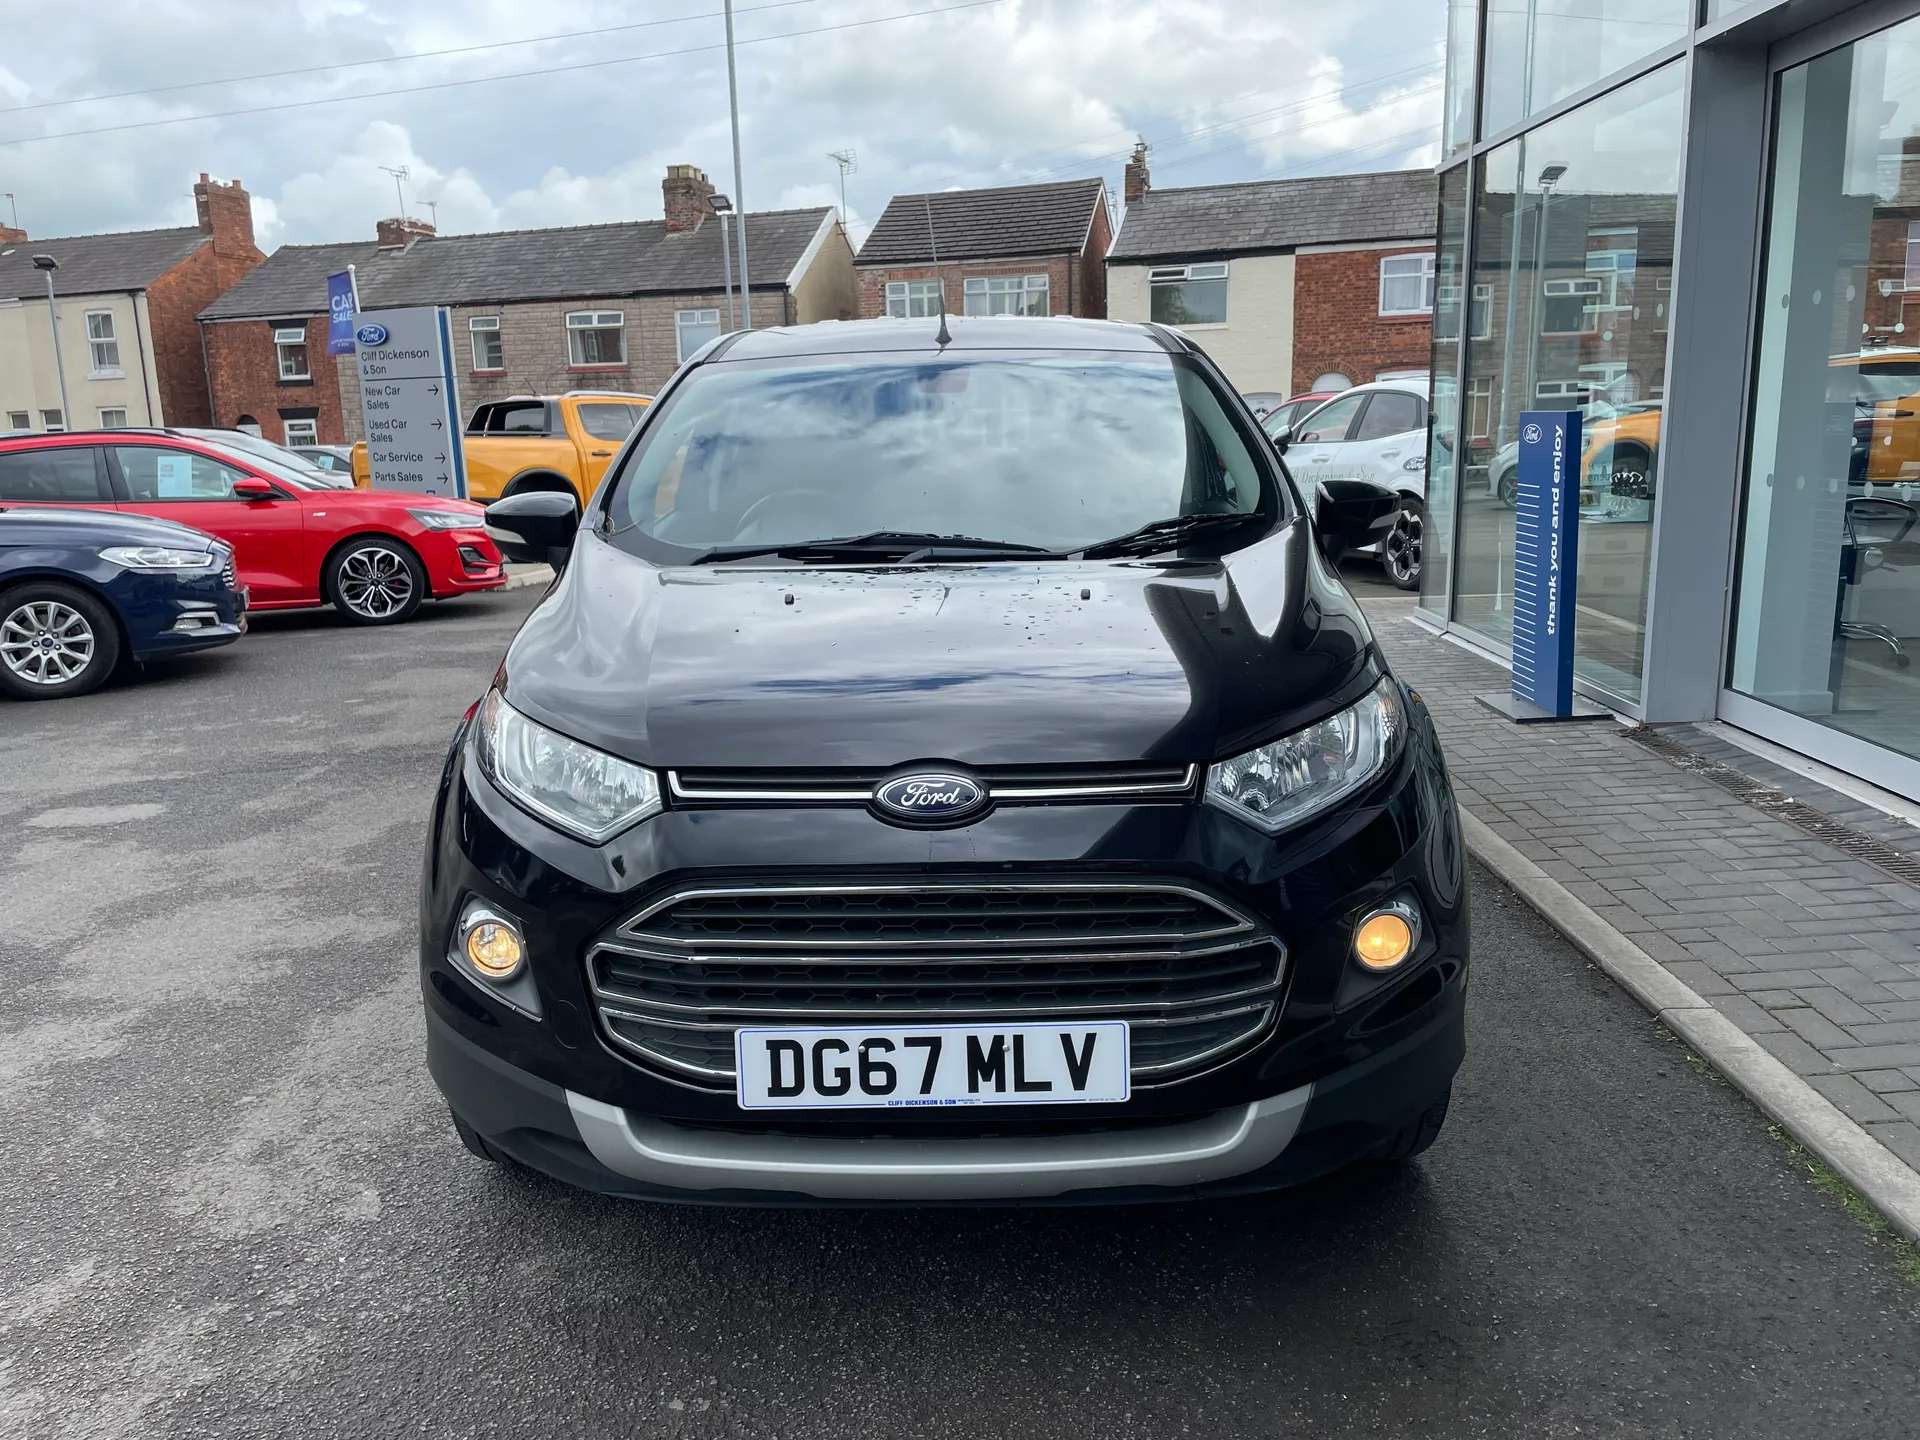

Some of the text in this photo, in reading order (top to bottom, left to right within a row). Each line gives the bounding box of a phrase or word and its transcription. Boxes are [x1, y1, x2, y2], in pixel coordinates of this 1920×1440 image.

[361, 349, 430, 361] Cliff Dickenson
[363, 364, 387, 375] & Son
[365, 385, 401, 397] New Car
[367, 400, 390, 410] Sales
[369, 418, 408, 430] Used Car
[370, 432, 393, 443] Sales
[373, 451, 424, 462] Car Service
[375, 471, 424, 482] Parts Sales
[1547, 424, 1563, 635] thank you and enjoy
[900, 781, 961, 806] Ford
[765, 1032, 1098, 1097] DG67 MLV
